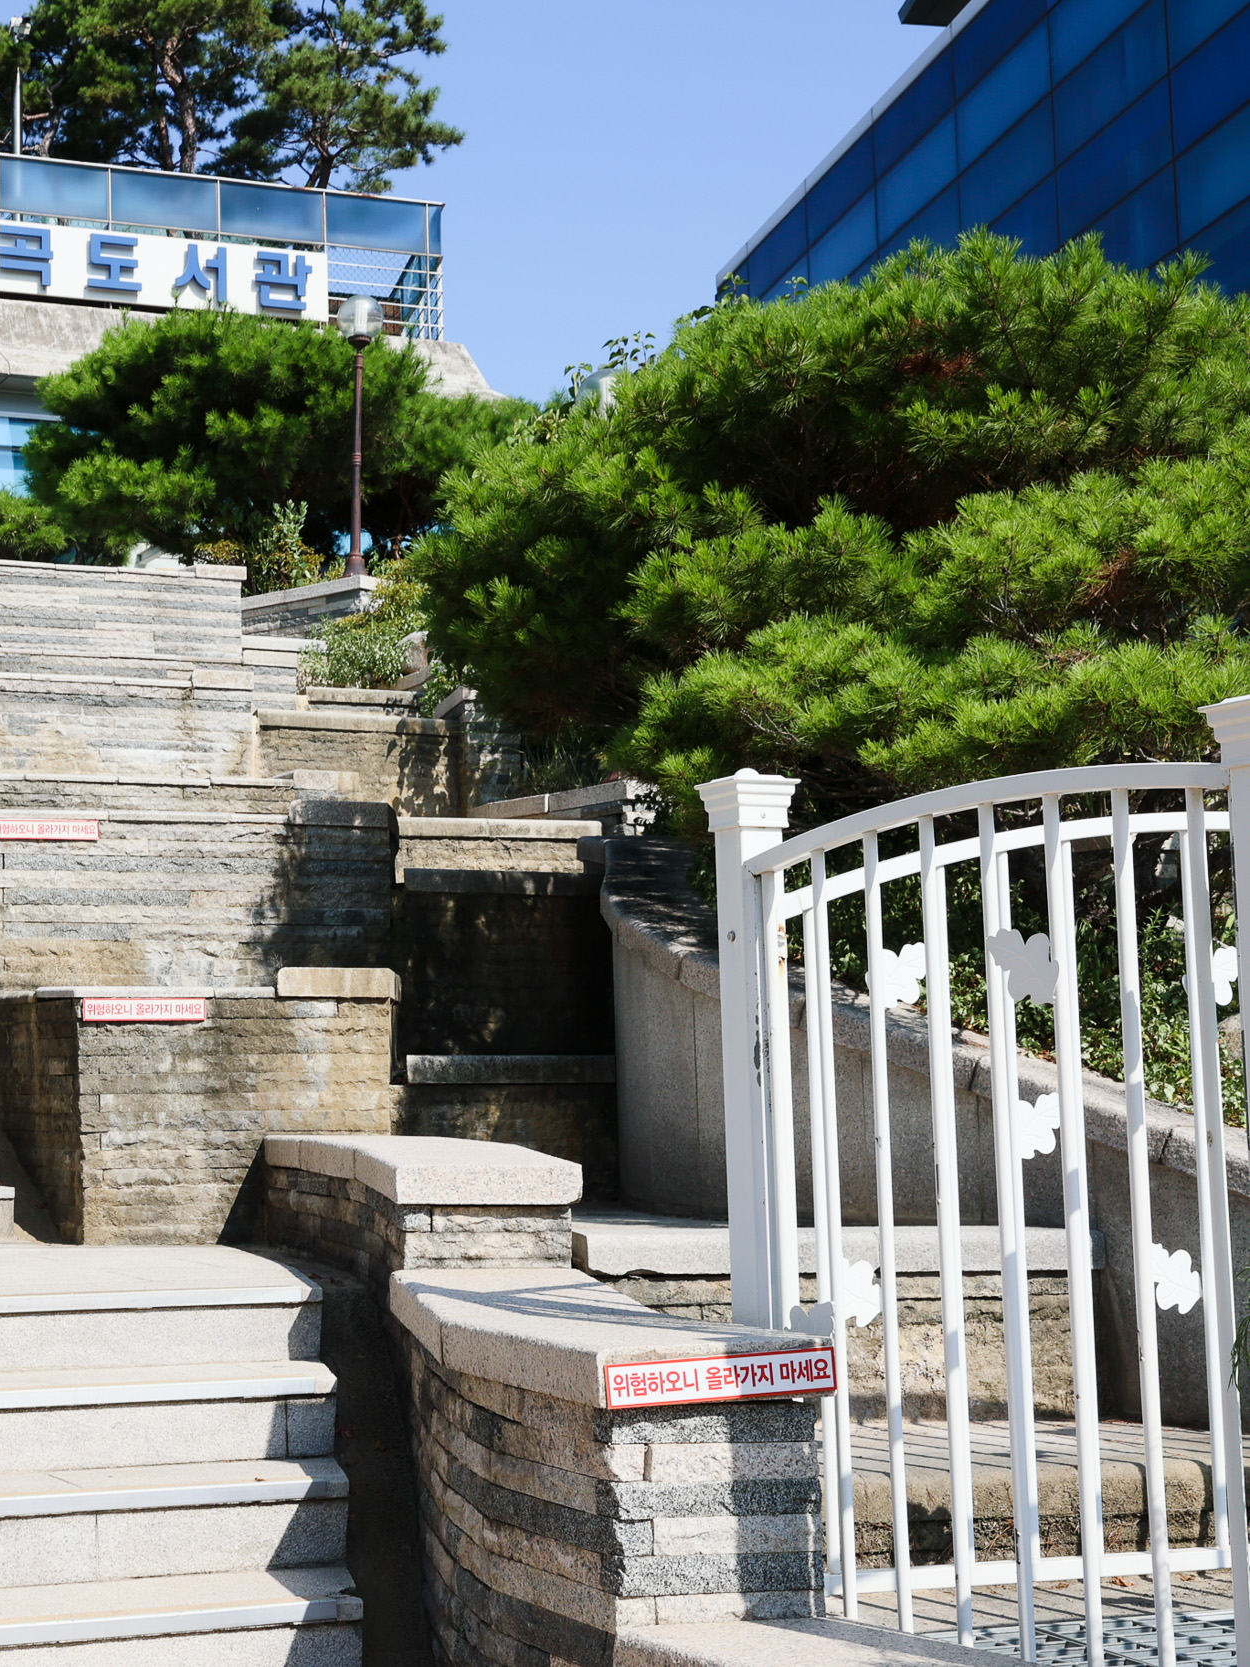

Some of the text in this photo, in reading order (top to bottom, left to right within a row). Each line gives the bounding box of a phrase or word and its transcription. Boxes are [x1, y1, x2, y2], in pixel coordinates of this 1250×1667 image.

[37, 823, 70, 835] 올라가지
[72, 824, 97, 835] 마세요
[86, 1002, 203, 1016] 위험하오니 올라가지 마세요
[612, 1358, 832, 1398] 위험하오니 올라가지 마세요
